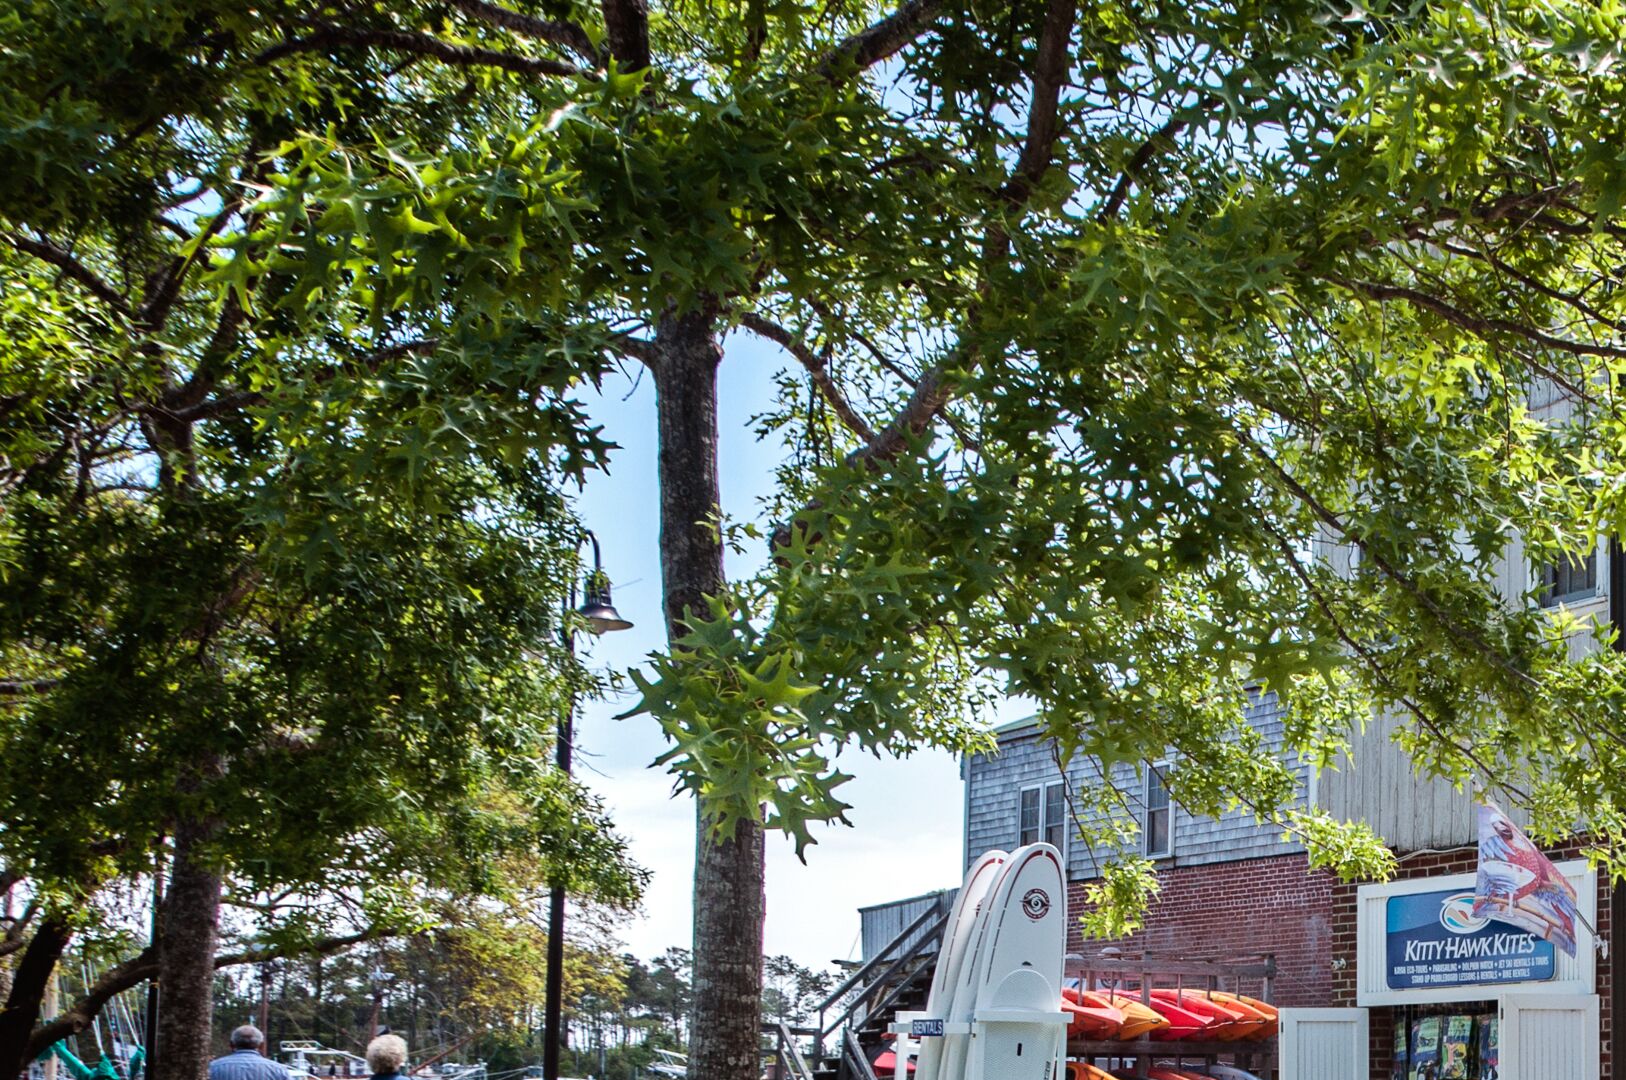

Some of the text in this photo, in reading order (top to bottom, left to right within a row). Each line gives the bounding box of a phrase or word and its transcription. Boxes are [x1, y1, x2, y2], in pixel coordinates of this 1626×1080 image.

[1404, 933, 1536, 961] KITTY HAWK KITES
[1432, 963, 1458, 972] PARASAILING
[1462, 962, 1480, 971] DOLPHIN
[1480, 960, 1494, 970] WATCH
[1514, 958, 1531, 968] RENTALS
[1536, 956, 1549, 966] TOURS
[1412, 975, 1424, 984] STAND
[1424, 974, 1430, 984] UP
[1430, 973, 1458, 982] PADDLEBOARD
[1459, 972, 1476, 982] LESSONS
[1480, 970, 1498, 980] RENTALS
[1502, 970, 1512, 978] BIKE
[1512, 968, 1530, 978] RENTALS
[913, 1021, 943, 1034] RENTALS
